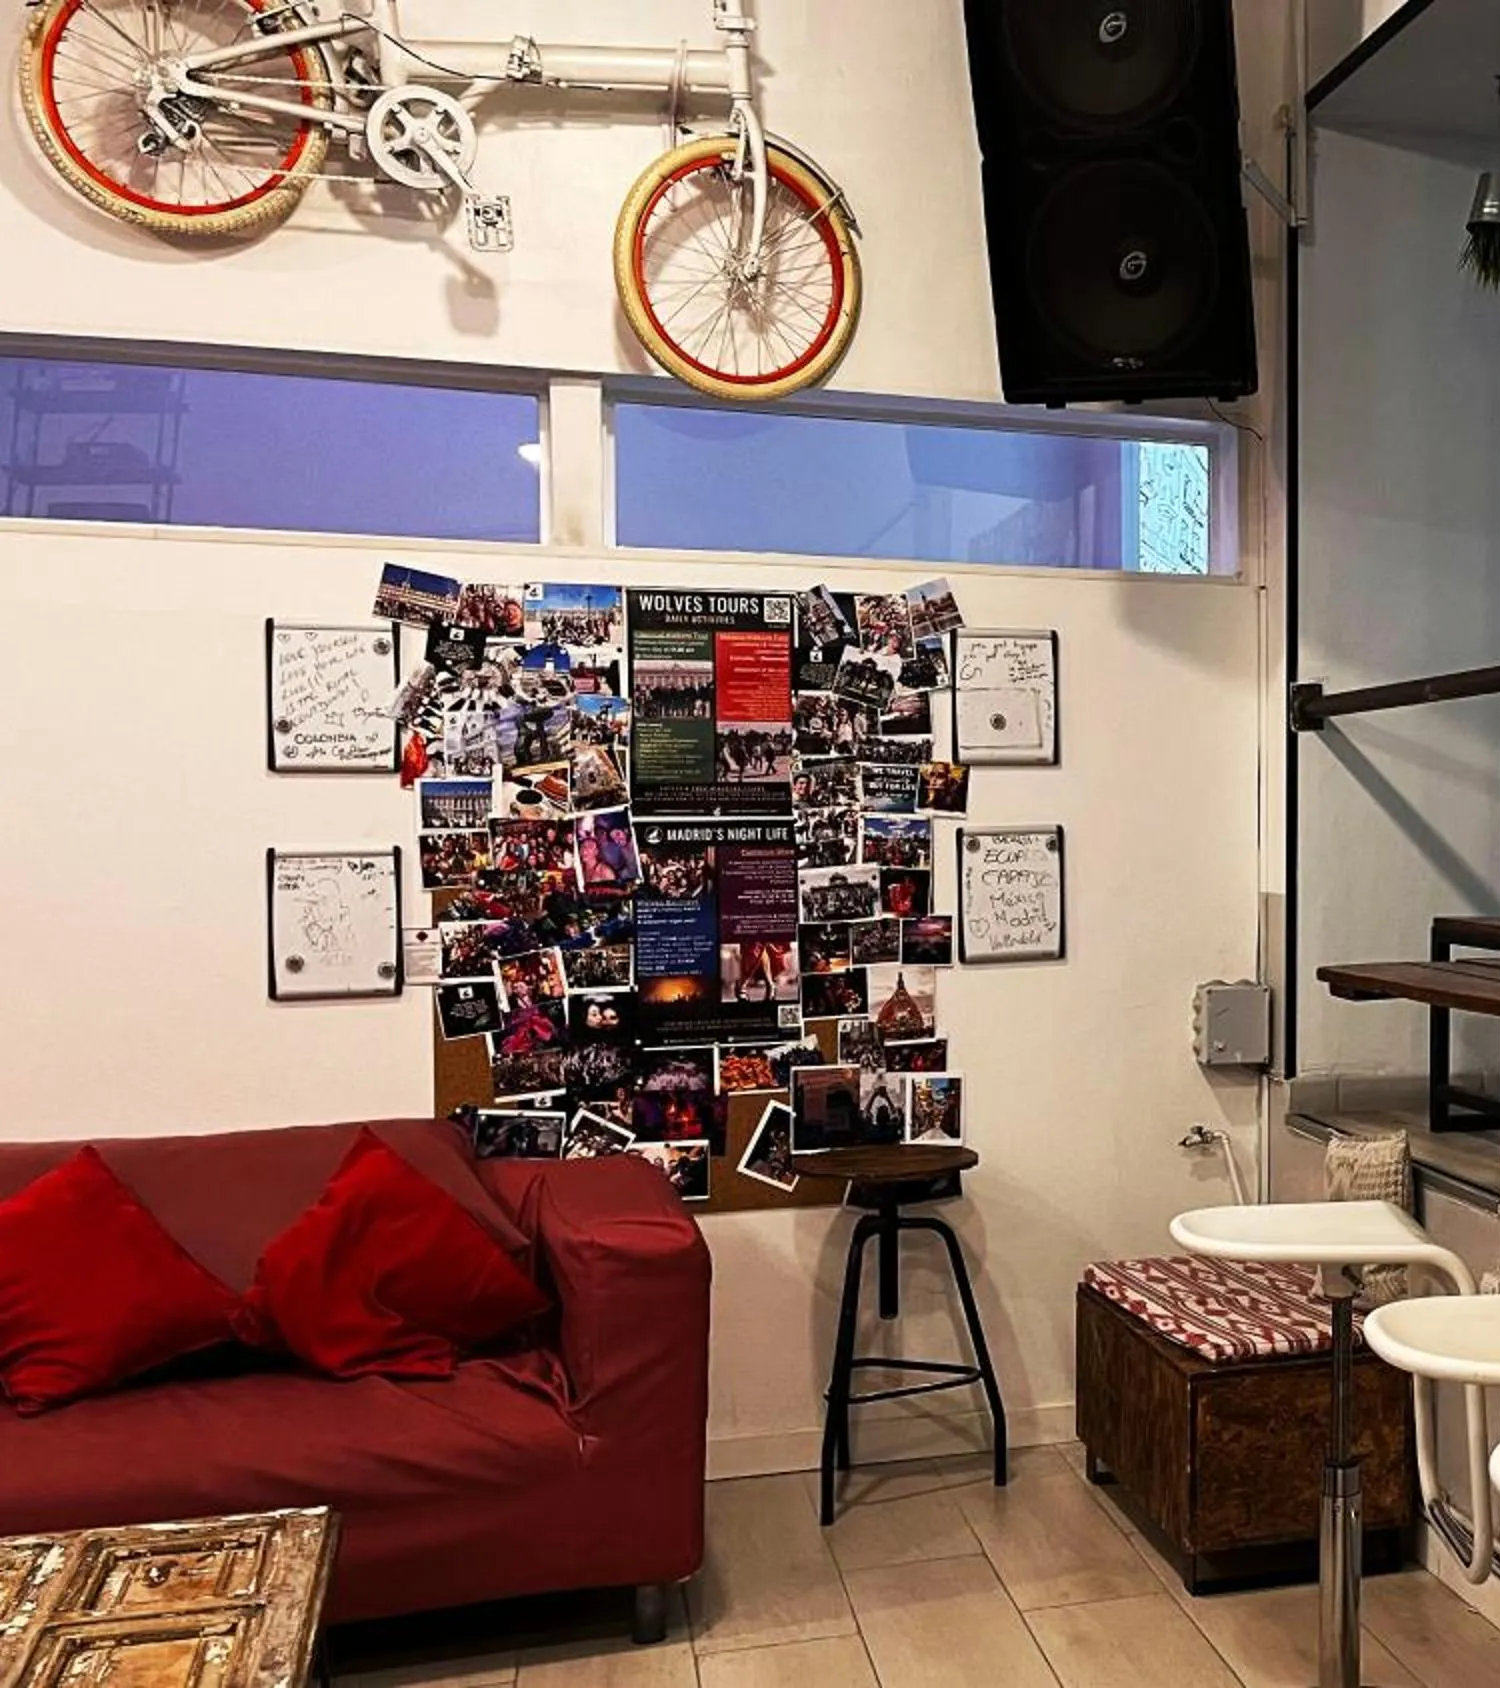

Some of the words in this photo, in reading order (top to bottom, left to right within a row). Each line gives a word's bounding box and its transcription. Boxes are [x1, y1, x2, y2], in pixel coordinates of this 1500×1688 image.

[639, 595, 703, 613] WOLVES
[709, 596, 760, 615] TOURS
[667, 827, 725, 841] MADRID'S
[727, 827, 762, 841] NIGHT
[765, 827, 789, 841] LIFE
